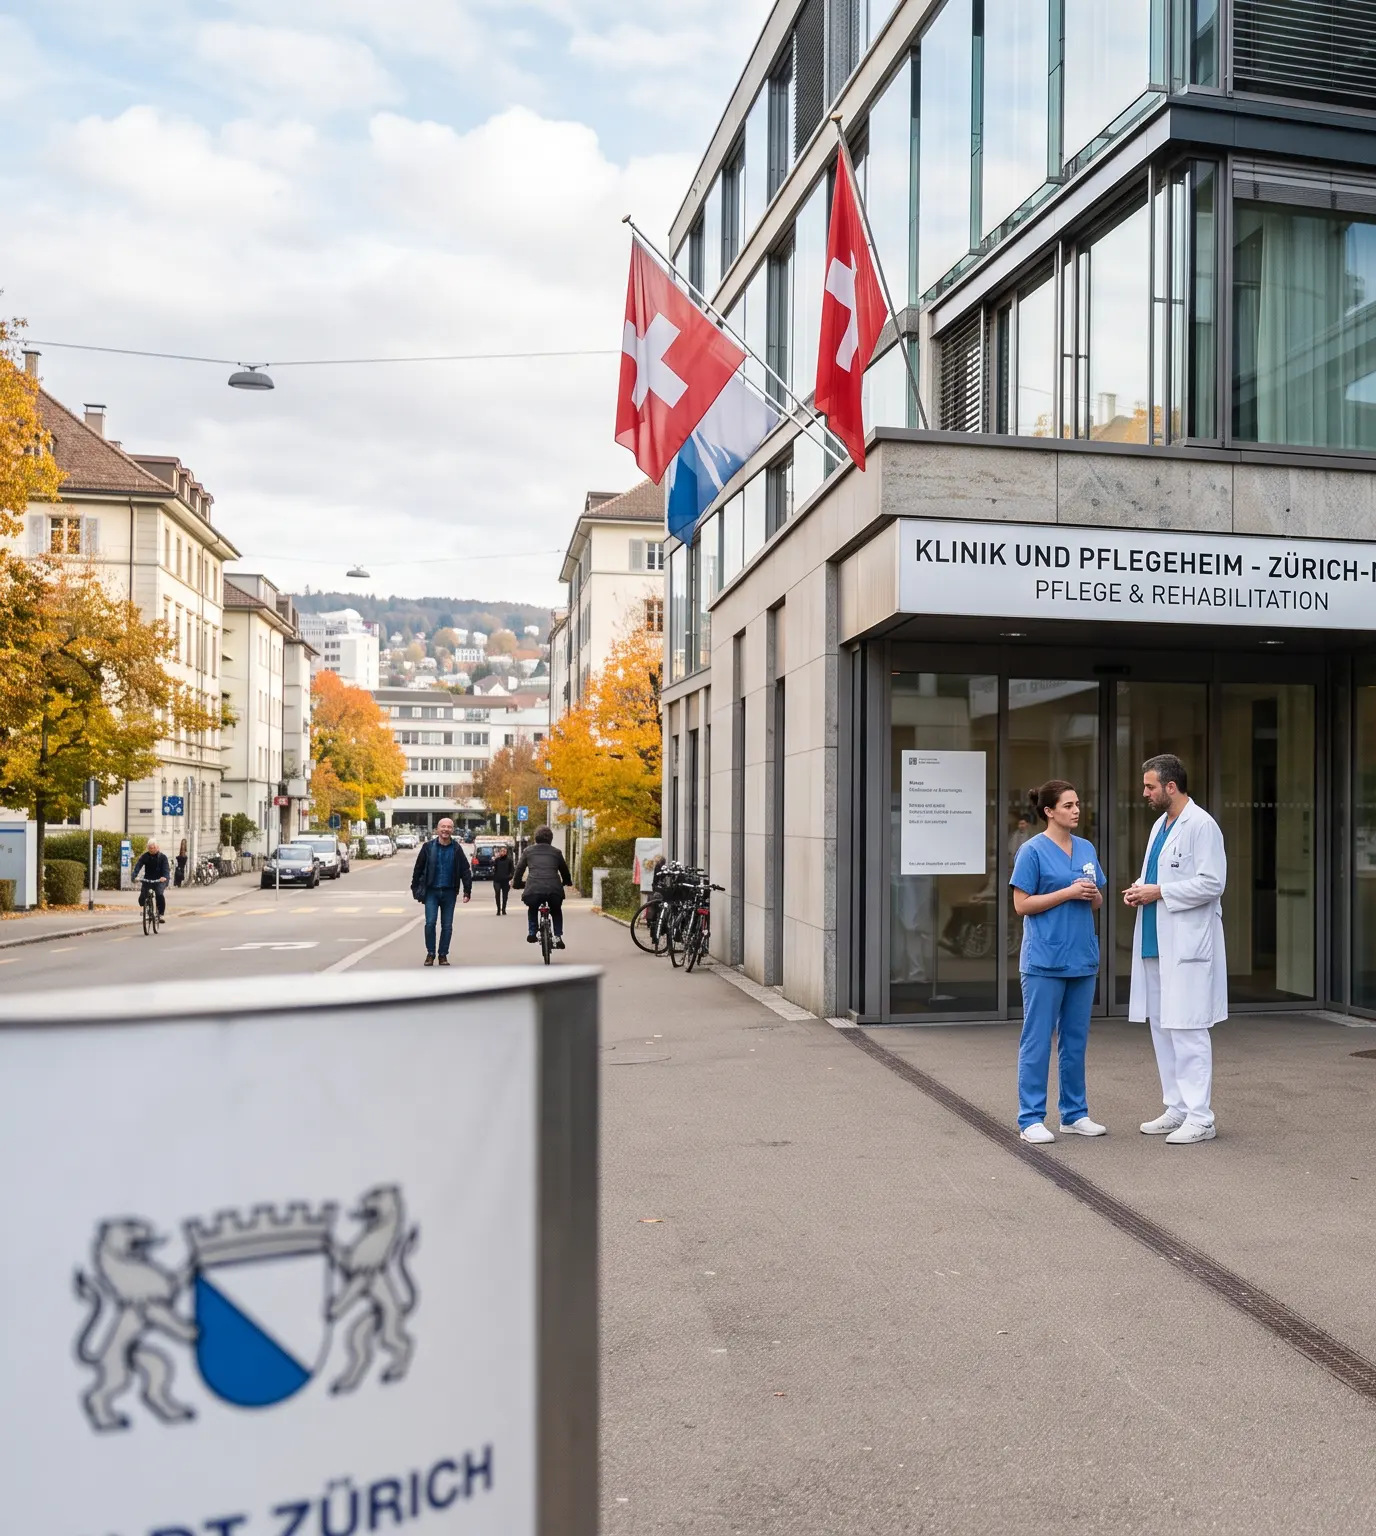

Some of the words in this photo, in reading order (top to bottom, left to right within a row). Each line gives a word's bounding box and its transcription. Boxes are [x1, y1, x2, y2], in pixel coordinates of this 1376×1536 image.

[916, 539, 1007, 566] KLINIK
[1015, 543, 1070, 568] UND
[1079, 547, 1243, 577] PFLEGEHEIM
[1036, 579, 1122, 603] PFLEGE
[1129, 583, 1144, 604] &
[1152, 584, 1328, 611] REHABILITATION
[271, 1443, 494, 1536] ZÜRICH
